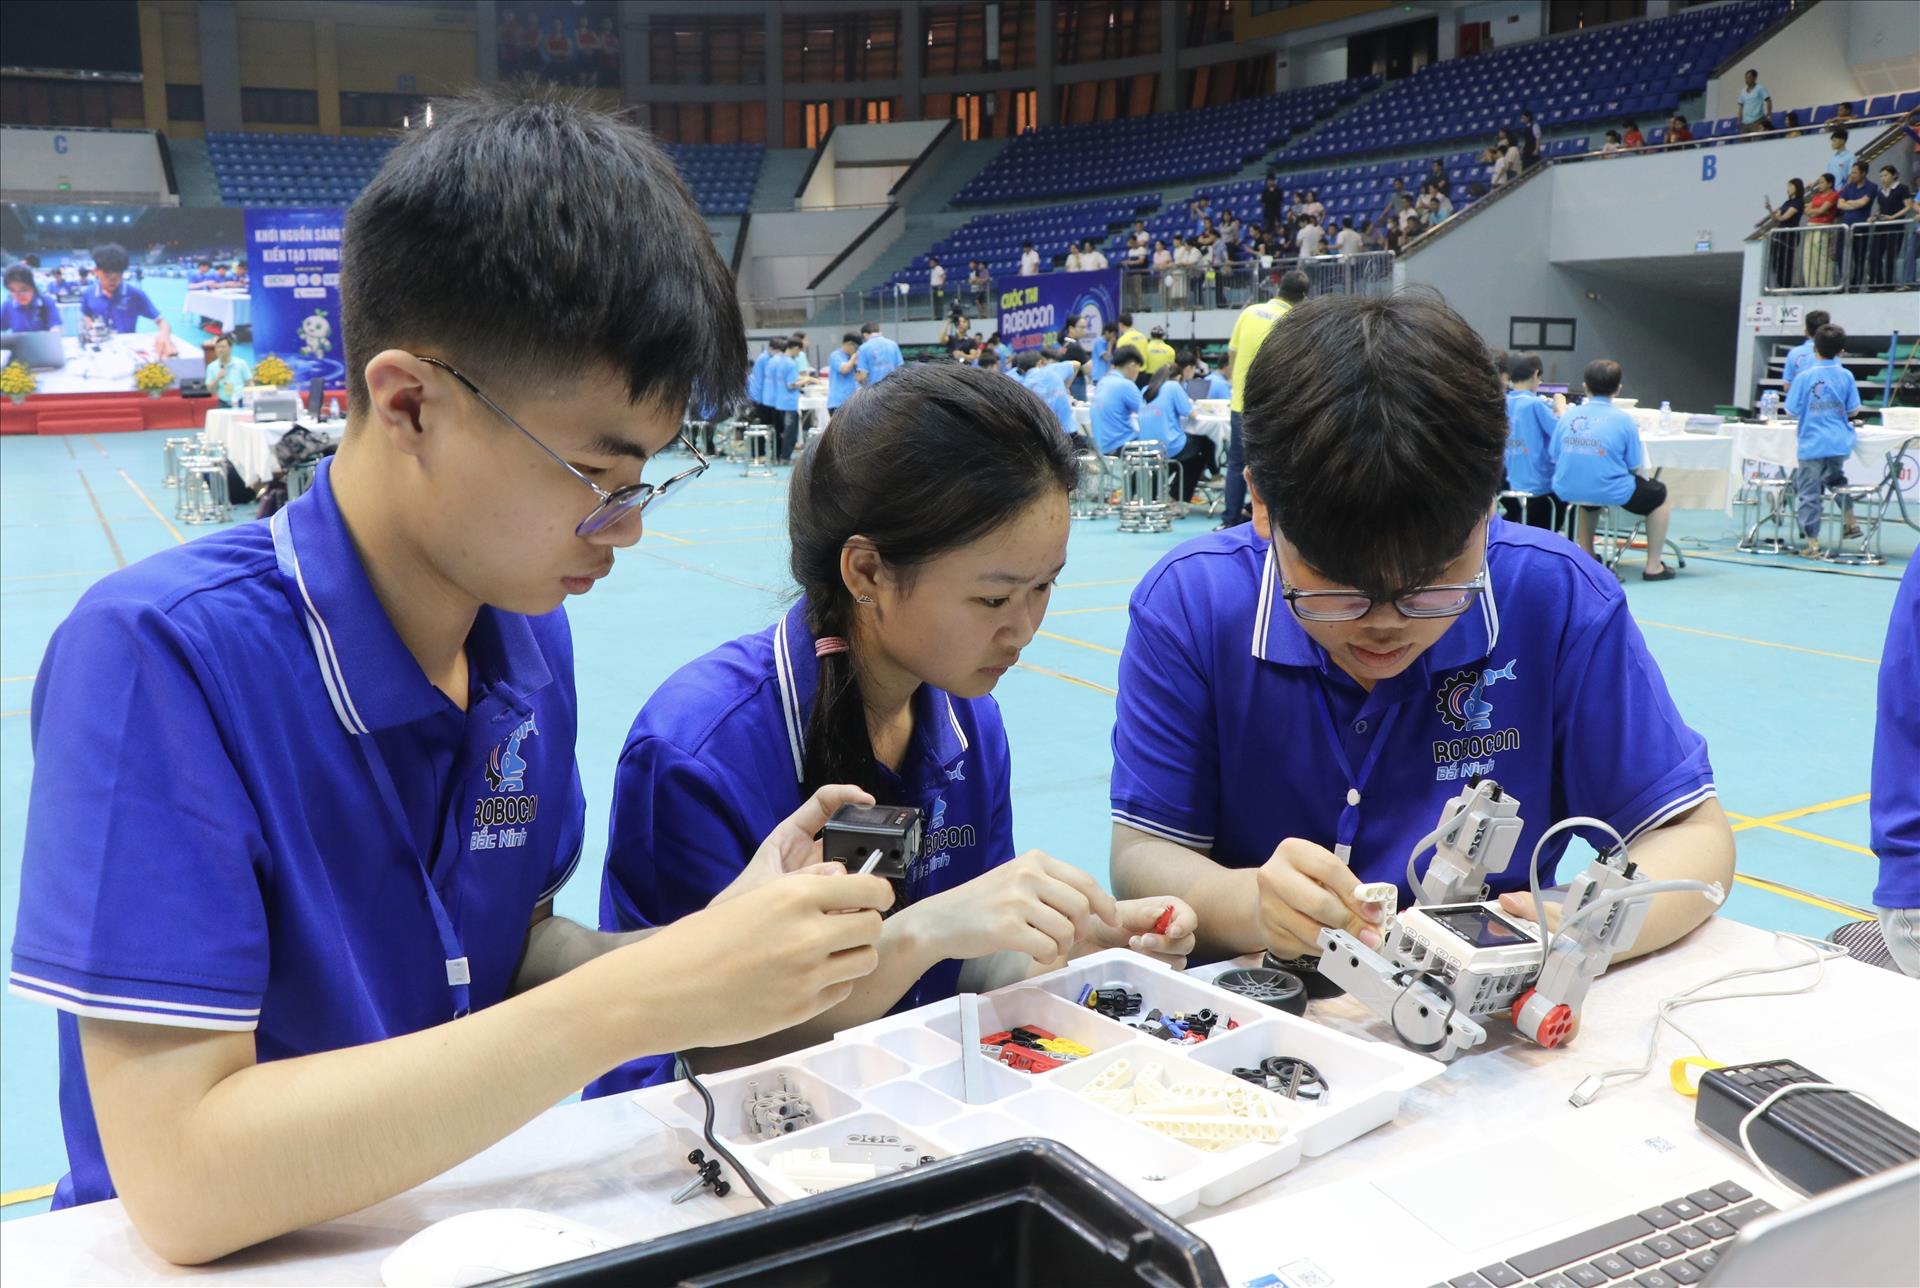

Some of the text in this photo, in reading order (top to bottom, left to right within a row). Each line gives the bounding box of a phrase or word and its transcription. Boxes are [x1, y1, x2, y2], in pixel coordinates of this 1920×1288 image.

[53, 135, 68, 155] C
[1702, 154, 1717, 182] B
[1025, 286, 1038, 305] THI
[1002, 304, 1054, 335] ROBOCON
[1781, 307, 1798, 317] WC
[473, 794, 538, 827] ROBOCO
[470, 826, 527, 850] Bắc Ninh
